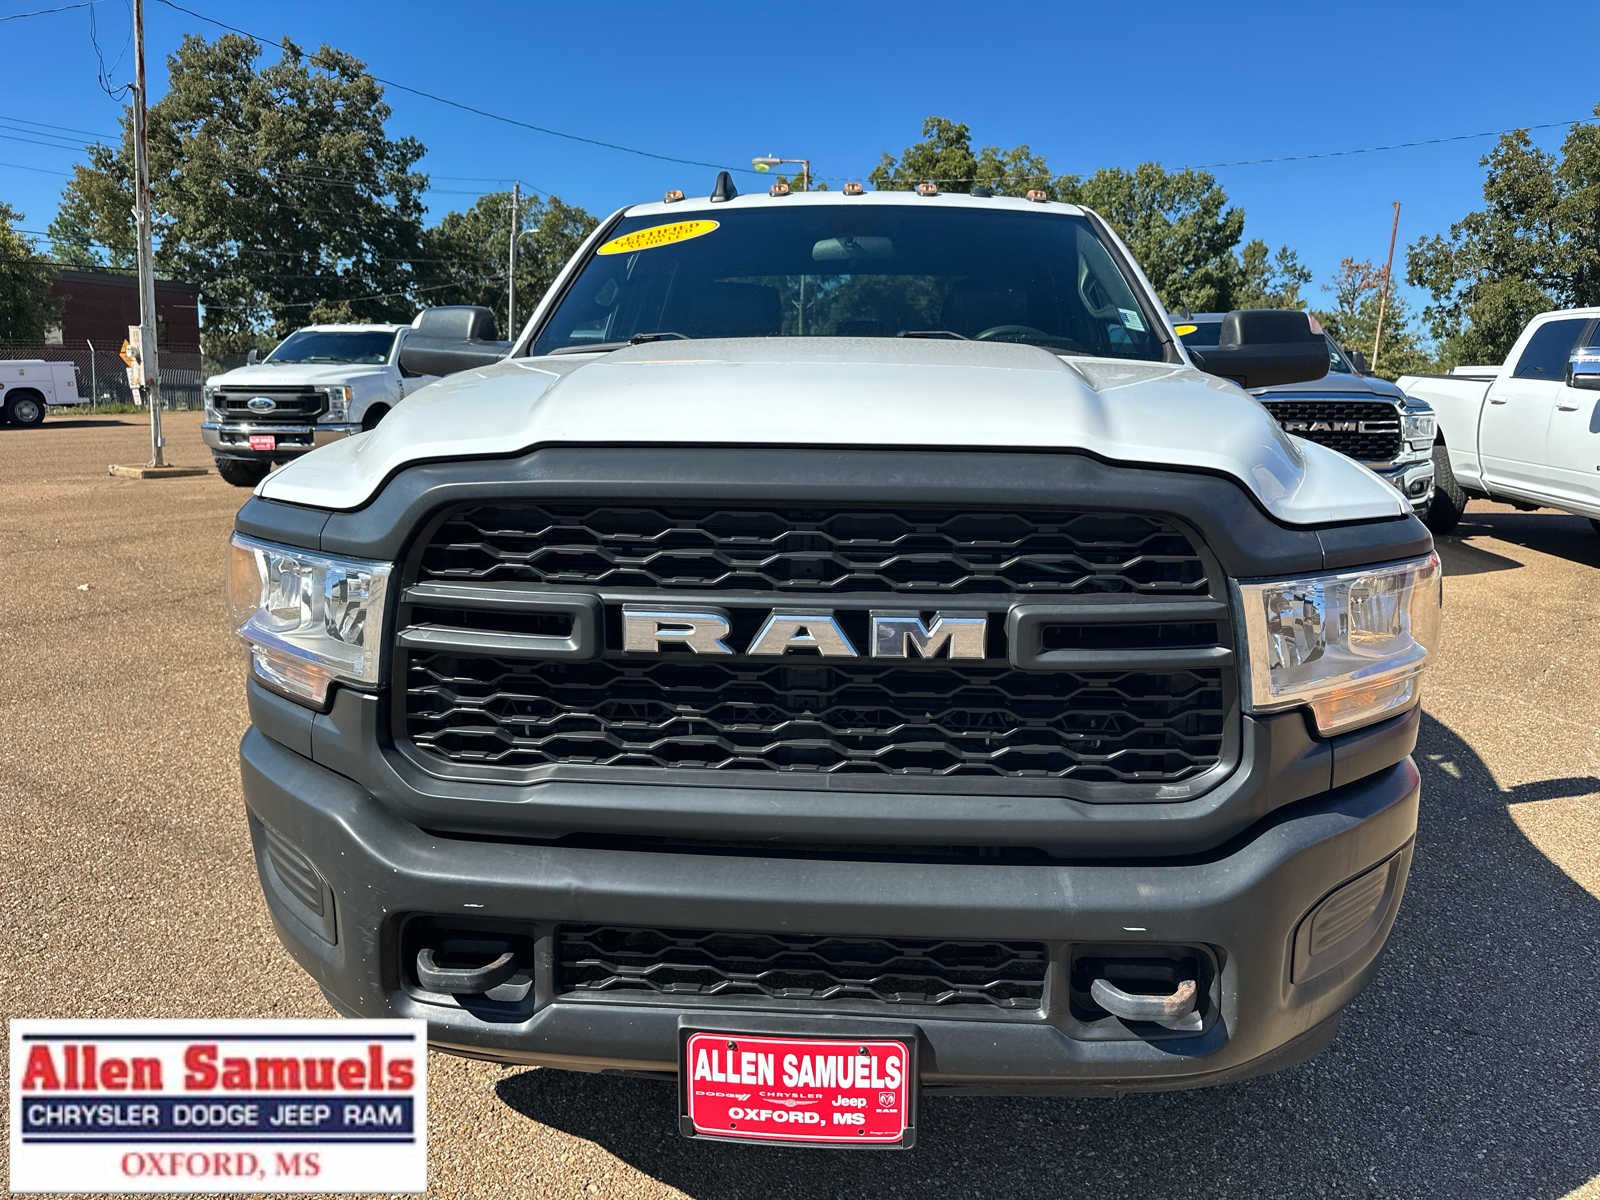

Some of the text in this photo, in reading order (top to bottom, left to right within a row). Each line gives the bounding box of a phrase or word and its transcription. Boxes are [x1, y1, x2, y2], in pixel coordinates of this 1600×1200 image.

[1285, 421, 1356, 432] RAM
[622, 603, 988, 659] RAM
[694, 1049, 901, 1089] ALLEN SAMUELS
[759, 1091, 823, 1099] CHRYSLER
[831, 1095, 867, 1109] Jeep
[728, 1108, 866, 1126] OXFORD, MS
